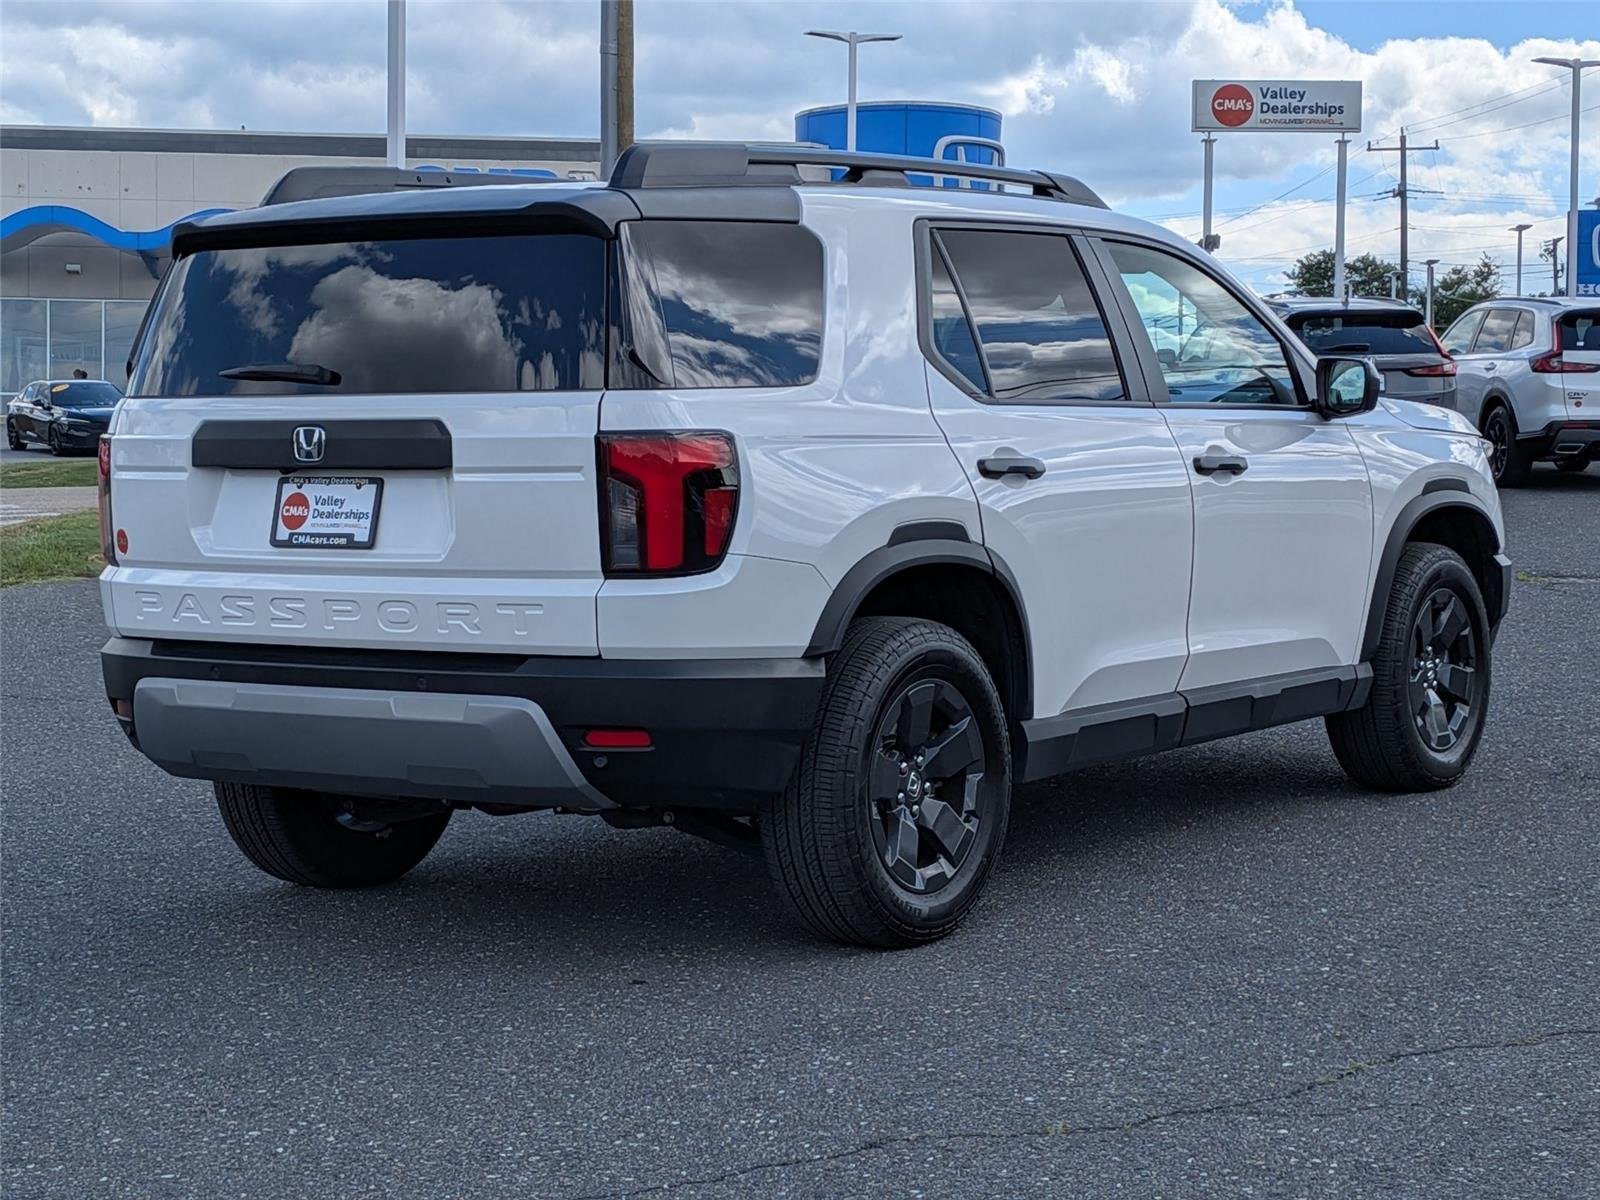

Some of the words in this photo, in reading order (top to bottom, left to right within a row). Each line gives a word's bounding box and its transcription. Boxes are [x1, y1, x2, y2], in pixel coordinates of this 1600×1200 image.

[1259, 87, 1306, 102] Valley
[1213, 98, 1252, 111] CMA's
[1260, 102, 1344, 117] Dealerships
[314, 495, 346, 509] Valley
[282, 505, 308, 516] CMA's
[312, 508, 370, 523] Dealerships
[292, 535, 347, 545] CMAcars.com
[134, 590, 545, 636] PASSPORT
